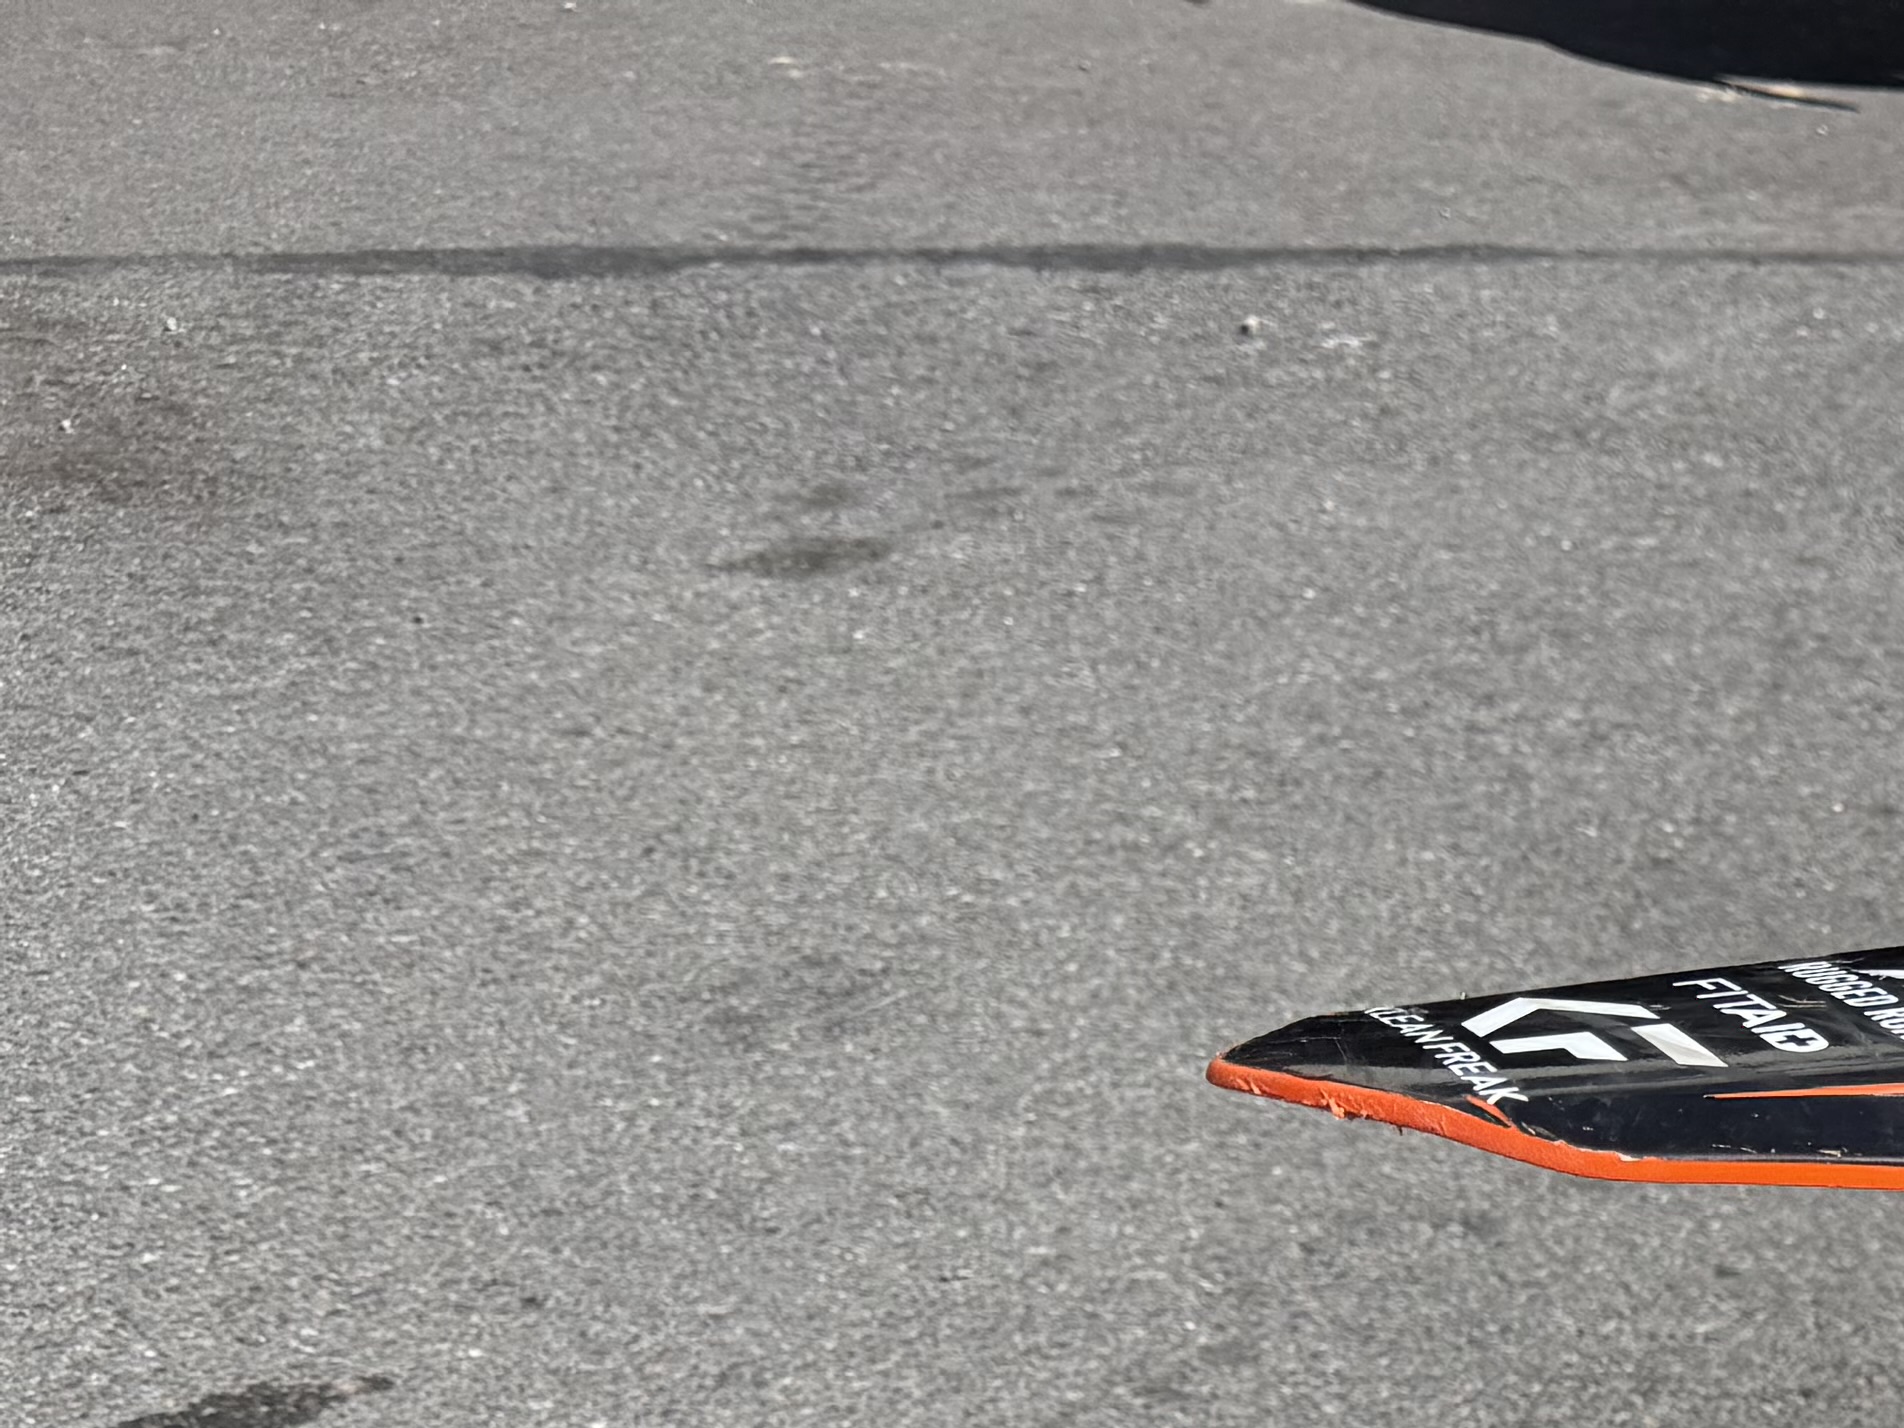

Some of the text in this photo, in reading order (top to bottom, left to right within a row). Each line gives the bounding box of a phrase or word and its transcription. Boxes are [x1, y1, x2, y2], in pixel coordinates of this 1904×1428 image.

[1673, 977, 1829, 1052] FITAID
[1778, 961, 1899, 1009] RUGGED
[1423, 1038, 1529, 1105] FREAK
